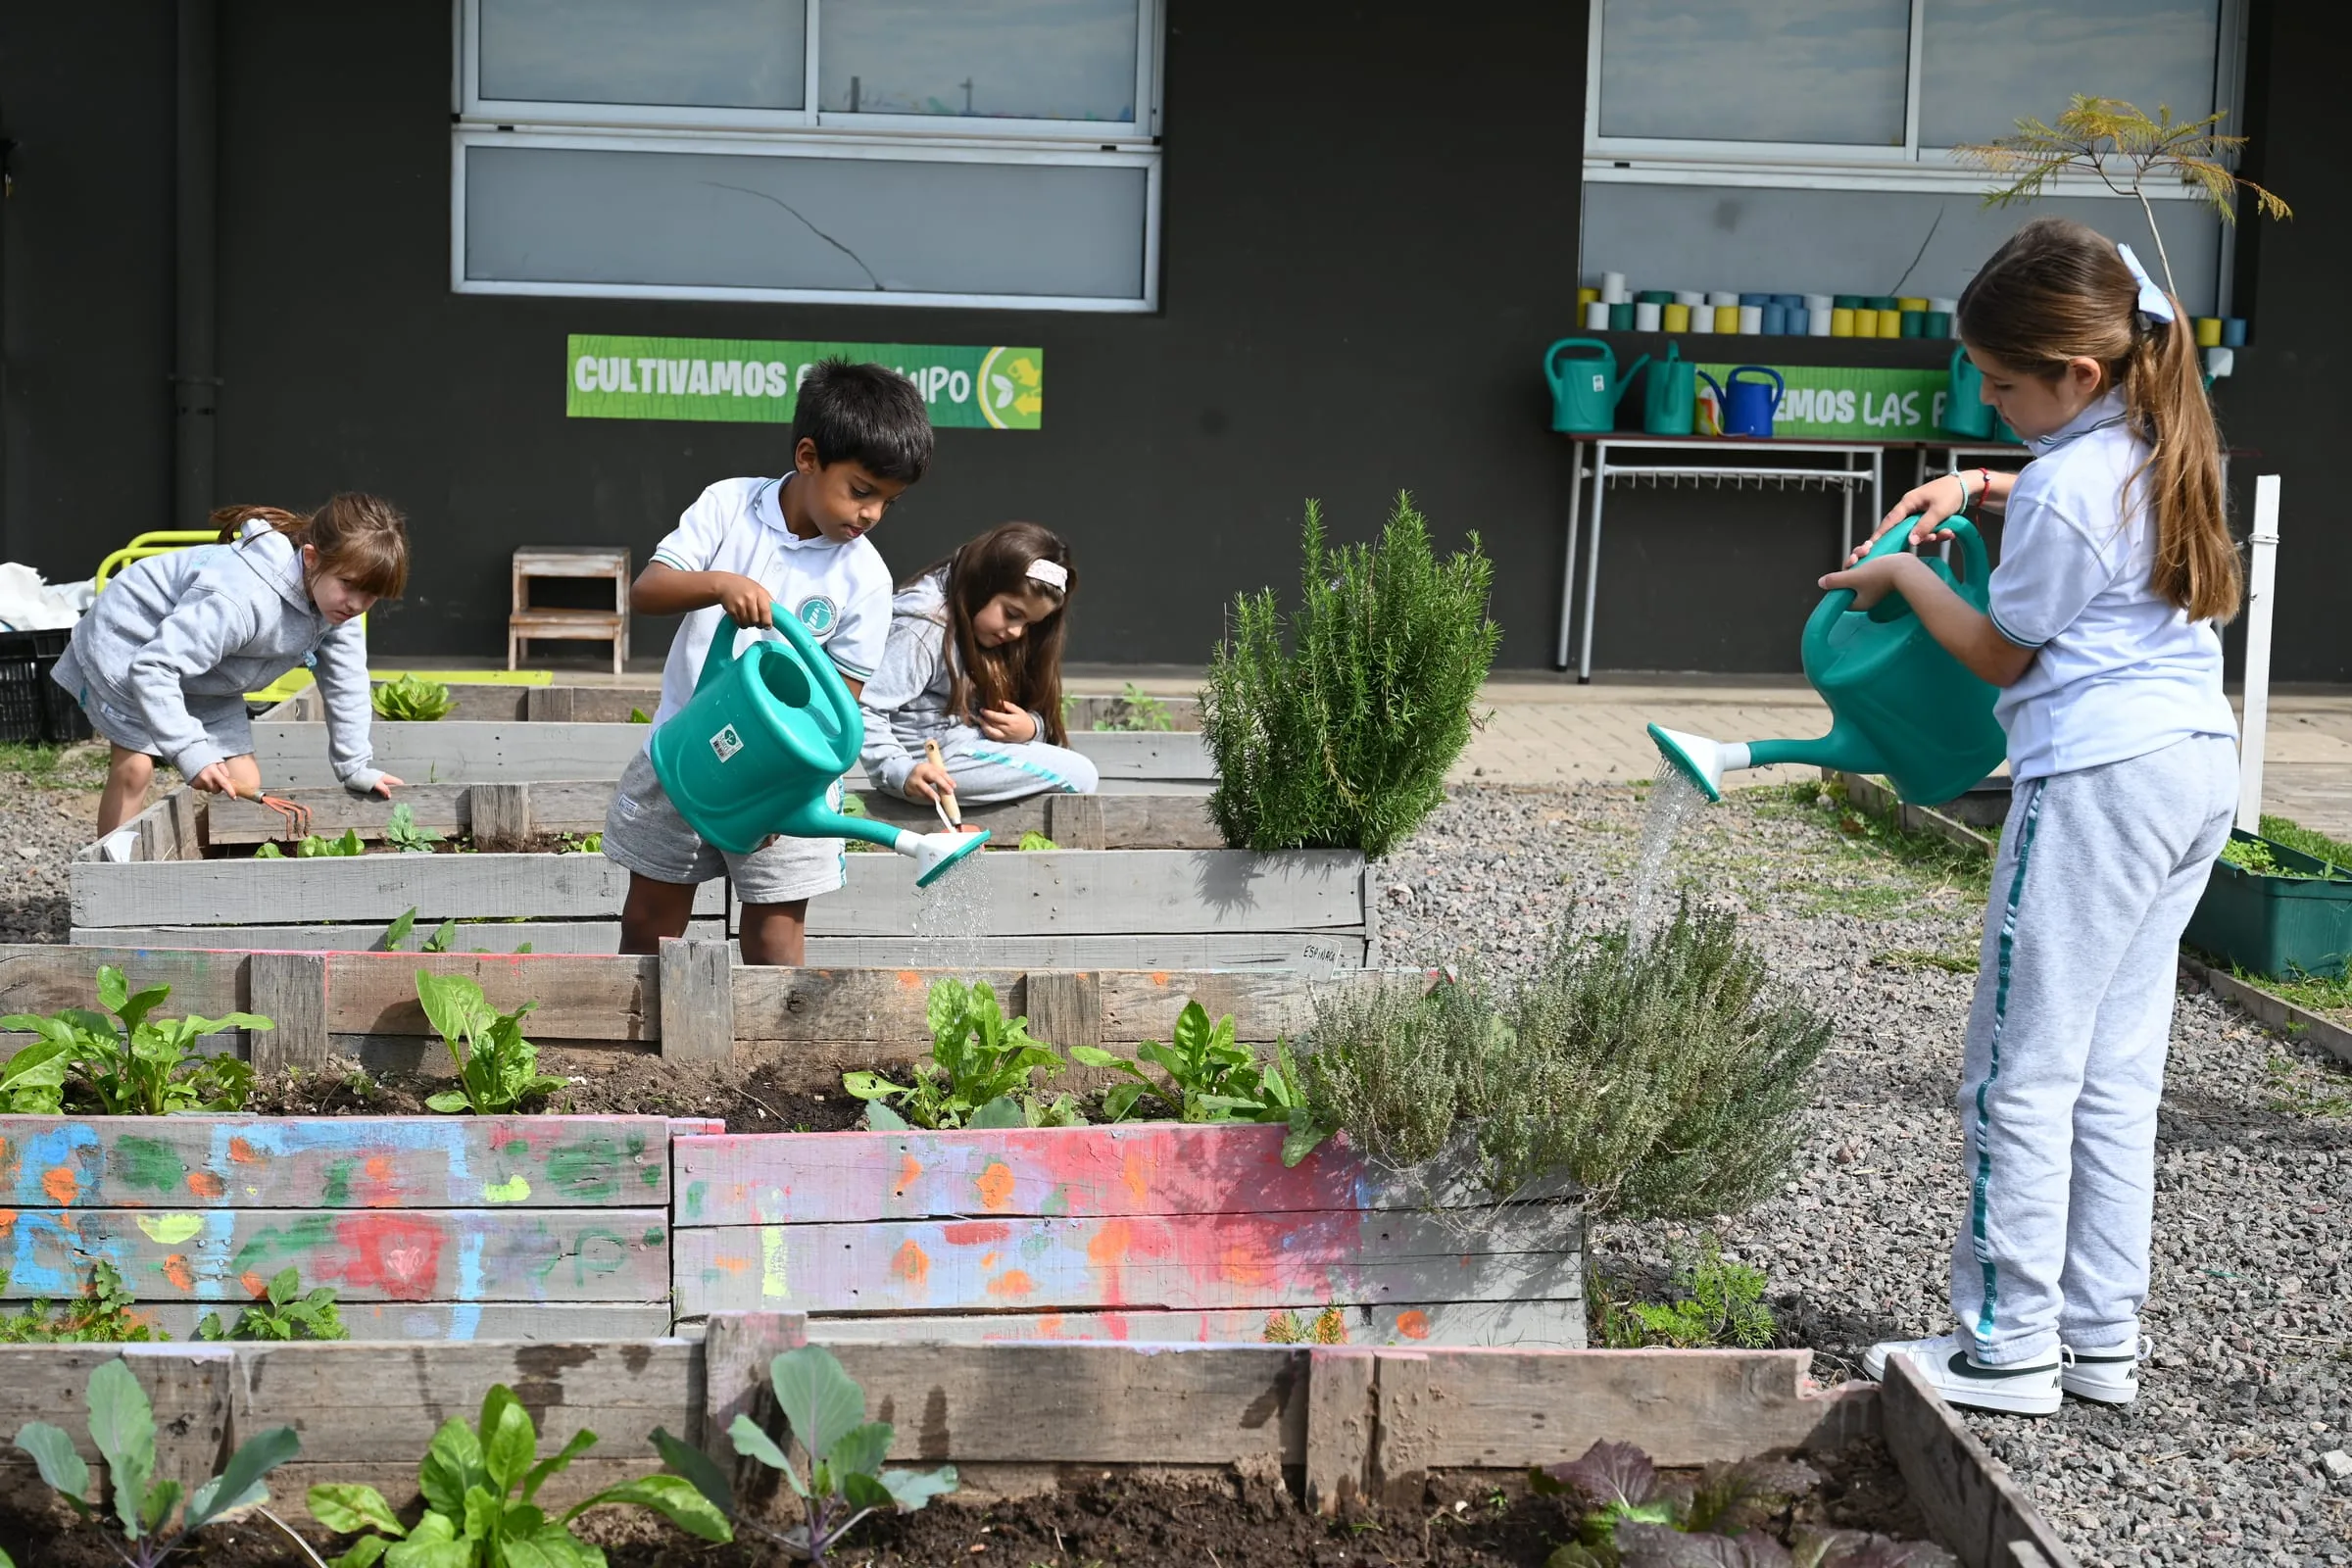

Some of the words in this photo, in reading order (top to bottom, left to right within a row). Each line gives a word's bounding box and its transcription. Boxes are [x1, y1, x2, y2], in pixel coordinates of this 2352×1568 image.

[574, 355, 787, 398] CULTIVAMOS
[894, 365, 971, 405] IPO
[1863, 390, 1922, 427] LAS
